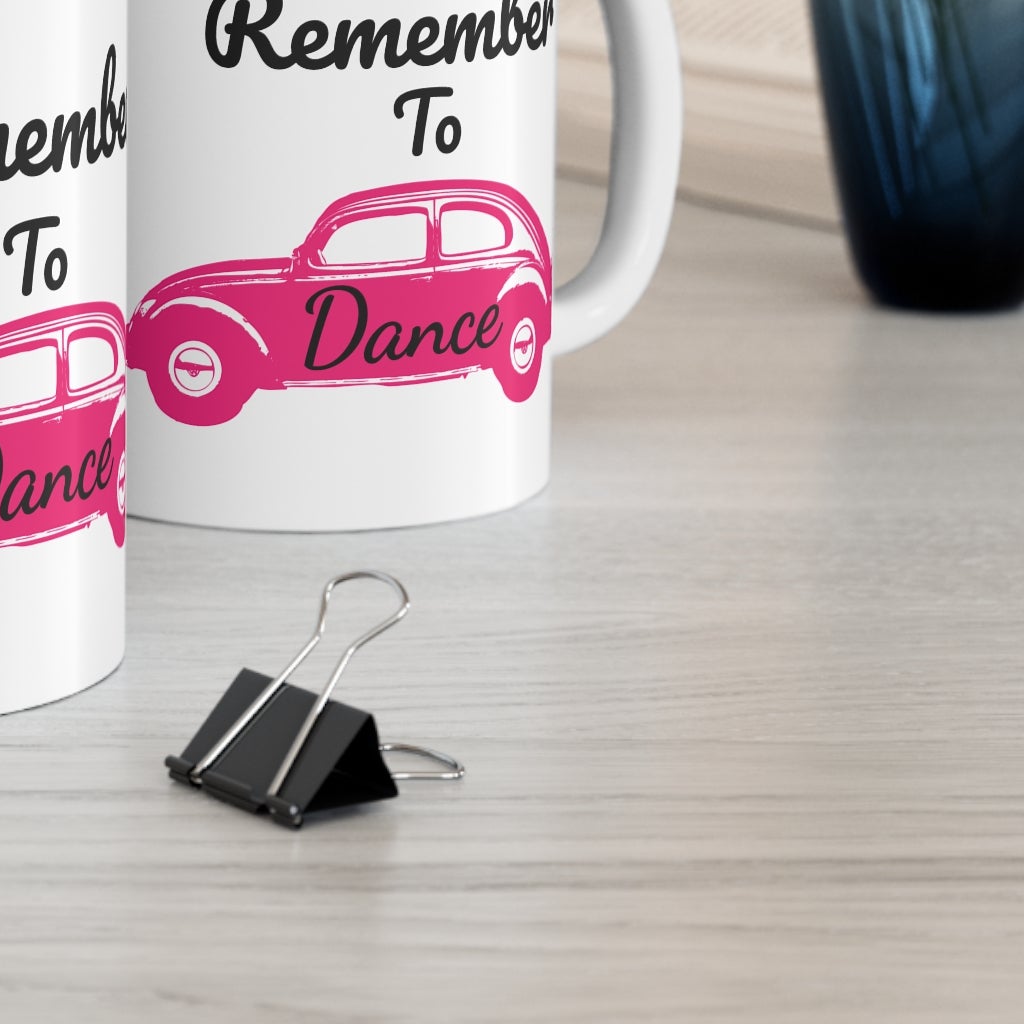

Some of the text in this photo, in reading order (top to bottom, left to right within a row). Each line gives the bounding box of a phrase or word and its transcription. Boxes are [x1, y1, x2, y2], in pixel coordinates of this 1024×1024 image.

[393, 86, 462, 157] To
[2, 216, 69, 297] To
[304, 285, 503, 371] Dance
